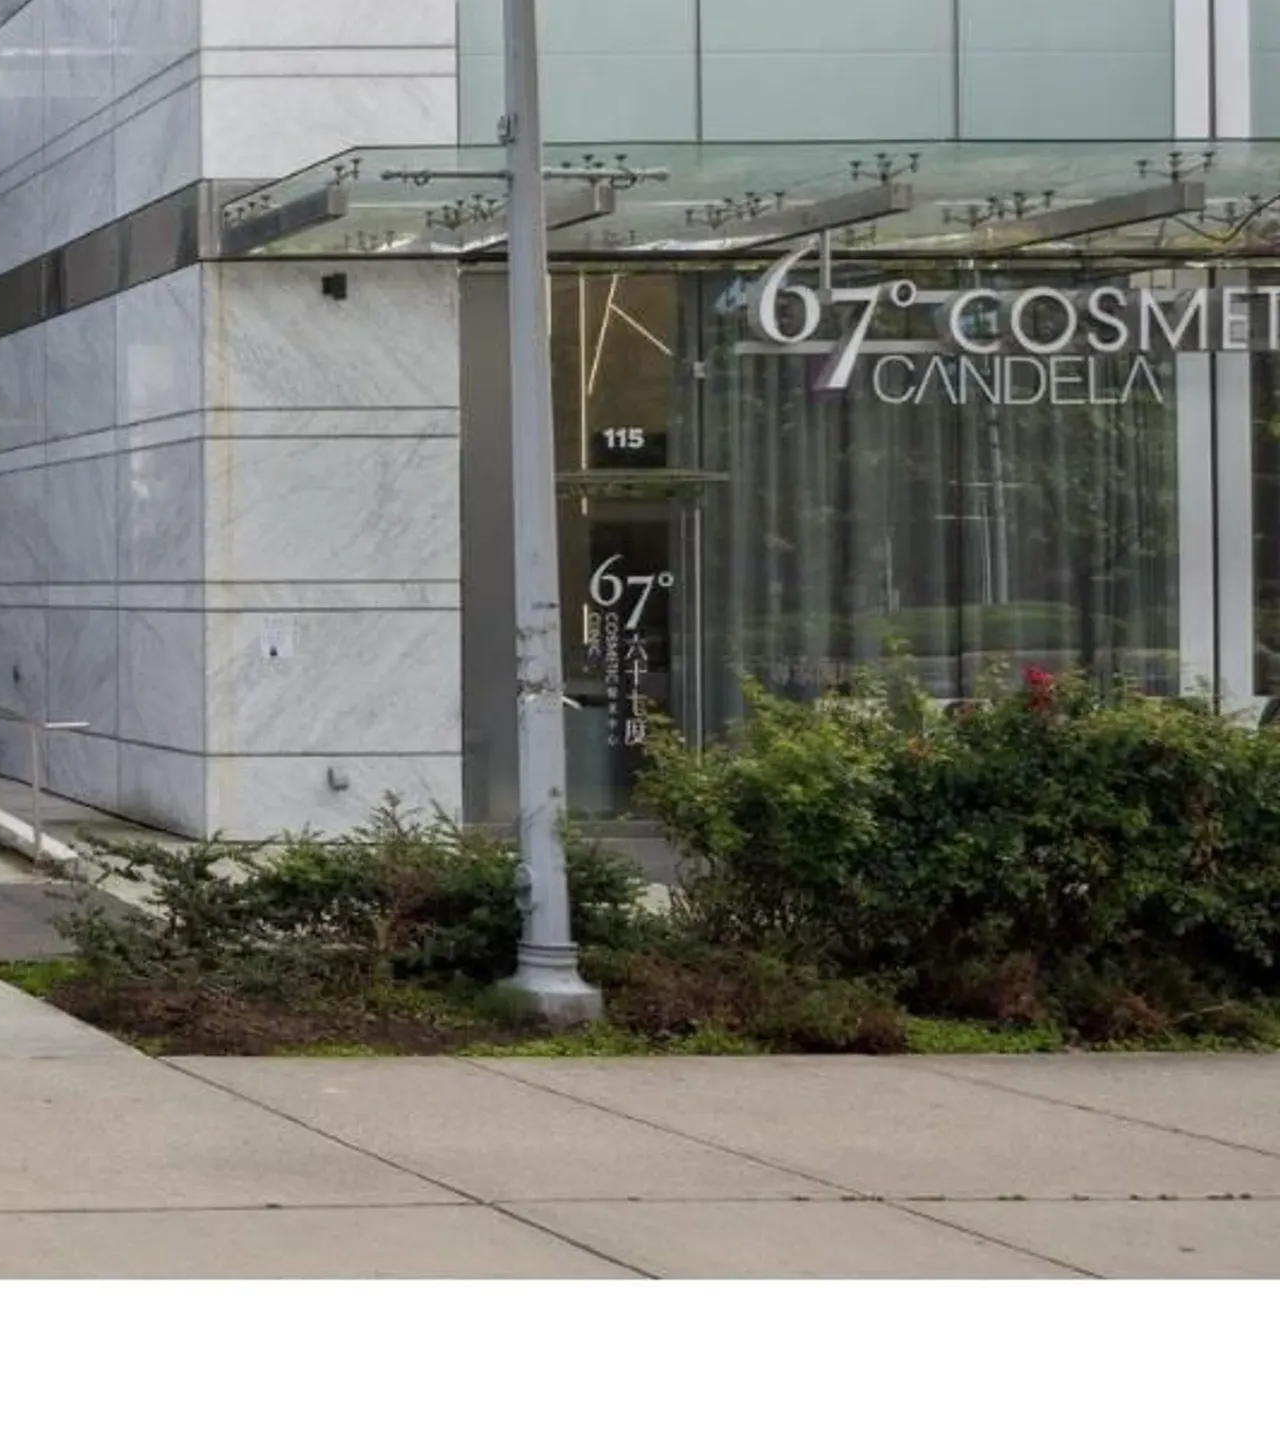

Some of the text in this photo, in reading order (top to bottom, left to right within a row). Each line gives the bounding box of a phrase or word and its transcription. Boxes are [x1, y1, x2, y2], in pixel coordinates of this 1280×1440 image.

[873, 355, 1164, 406] CANDELA
[603, 427, 645, 449] 115
[590, 554, 674, 630] 67°
